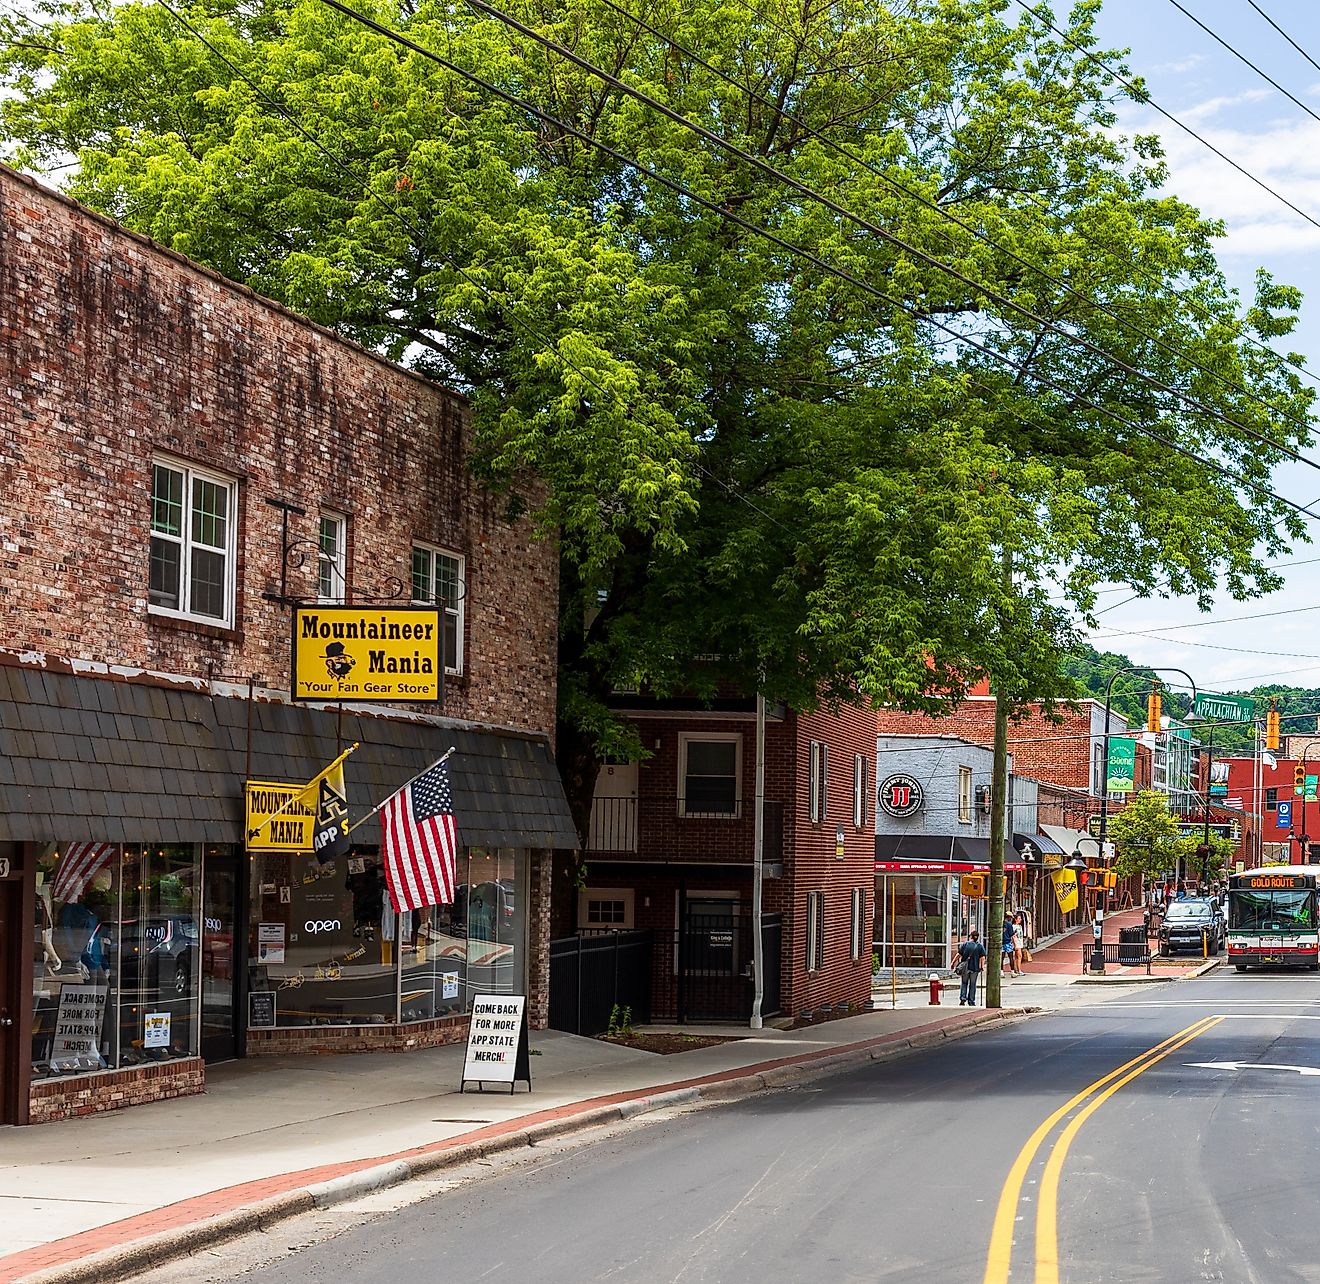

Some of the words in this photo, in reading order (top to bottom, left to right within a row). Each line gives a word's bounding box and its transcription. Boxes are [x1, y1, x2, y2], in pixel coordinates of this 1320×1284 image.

[301, 615, 434, 640] Mountaineer
[368, 650, 433, 674] Mania
[338, 682, 359, 692] Fan
[364, 683, 392, 693] Gear
[1196, 701, 1242, 720] APPALACHIAN
[1243, 707, 1250, 715] ST
[1110, 756, 1132, 765] Boone
[607, 767, 614, 775] 8
[891, 786, 911, 807] JJ
[270, 821, 304, 843] MANIA
[314, 826, 338, 851] APP
[1251, 878, 1270, 887] GOLD
[1271, 878, 1295, 887] ROUTE
[304, 920, 341, 935] open
[475, 1003, 496, 1014] COME
[497, 1004, 519, 1015] BACK
[475, 1018, 491, 1029] FOR
[493, 1020, 516, 1030] MORE
[471, 1035, 488, 1045] APP
[489, 1035, 515, 1047] STATE
[475, 1050, 506, 1062] MERCH!
